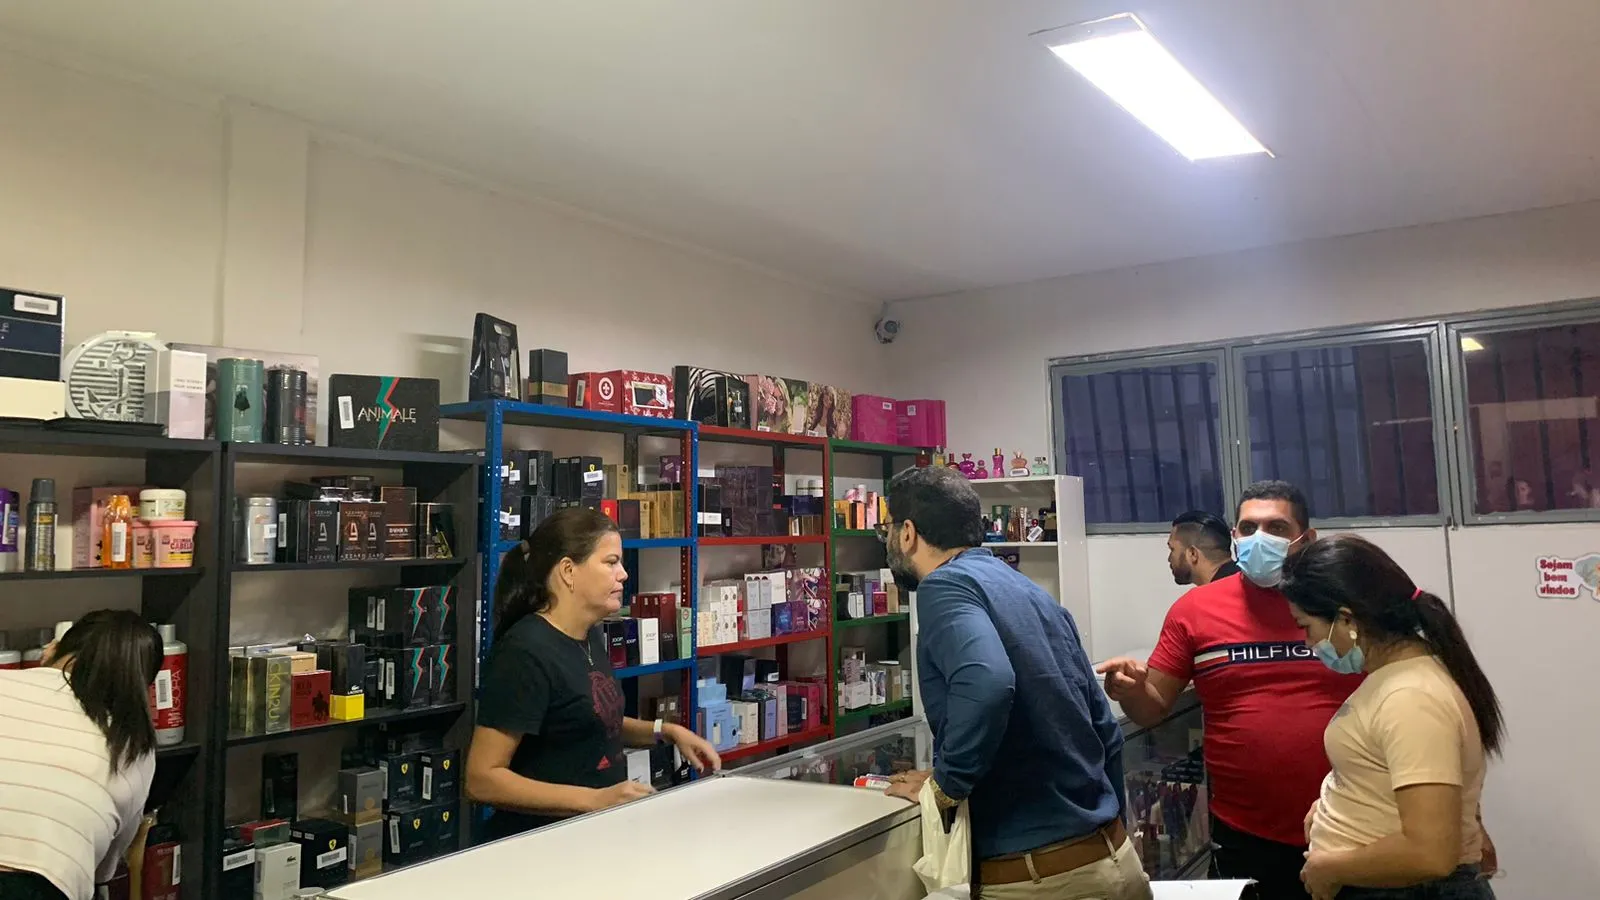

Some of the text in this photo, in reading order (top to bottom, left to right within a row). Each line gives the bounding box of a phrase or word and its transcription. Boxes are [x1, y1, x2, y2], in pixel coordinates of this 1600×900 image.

[357, 407, 416, 423] ANIMALE
[1540, 559, 1573, 572] Sejam
[1544, 572, 1568, 582] bem
[1540, 584, 1576, 595] vindos
[1231, 644, 1319, 661] HILFIG
